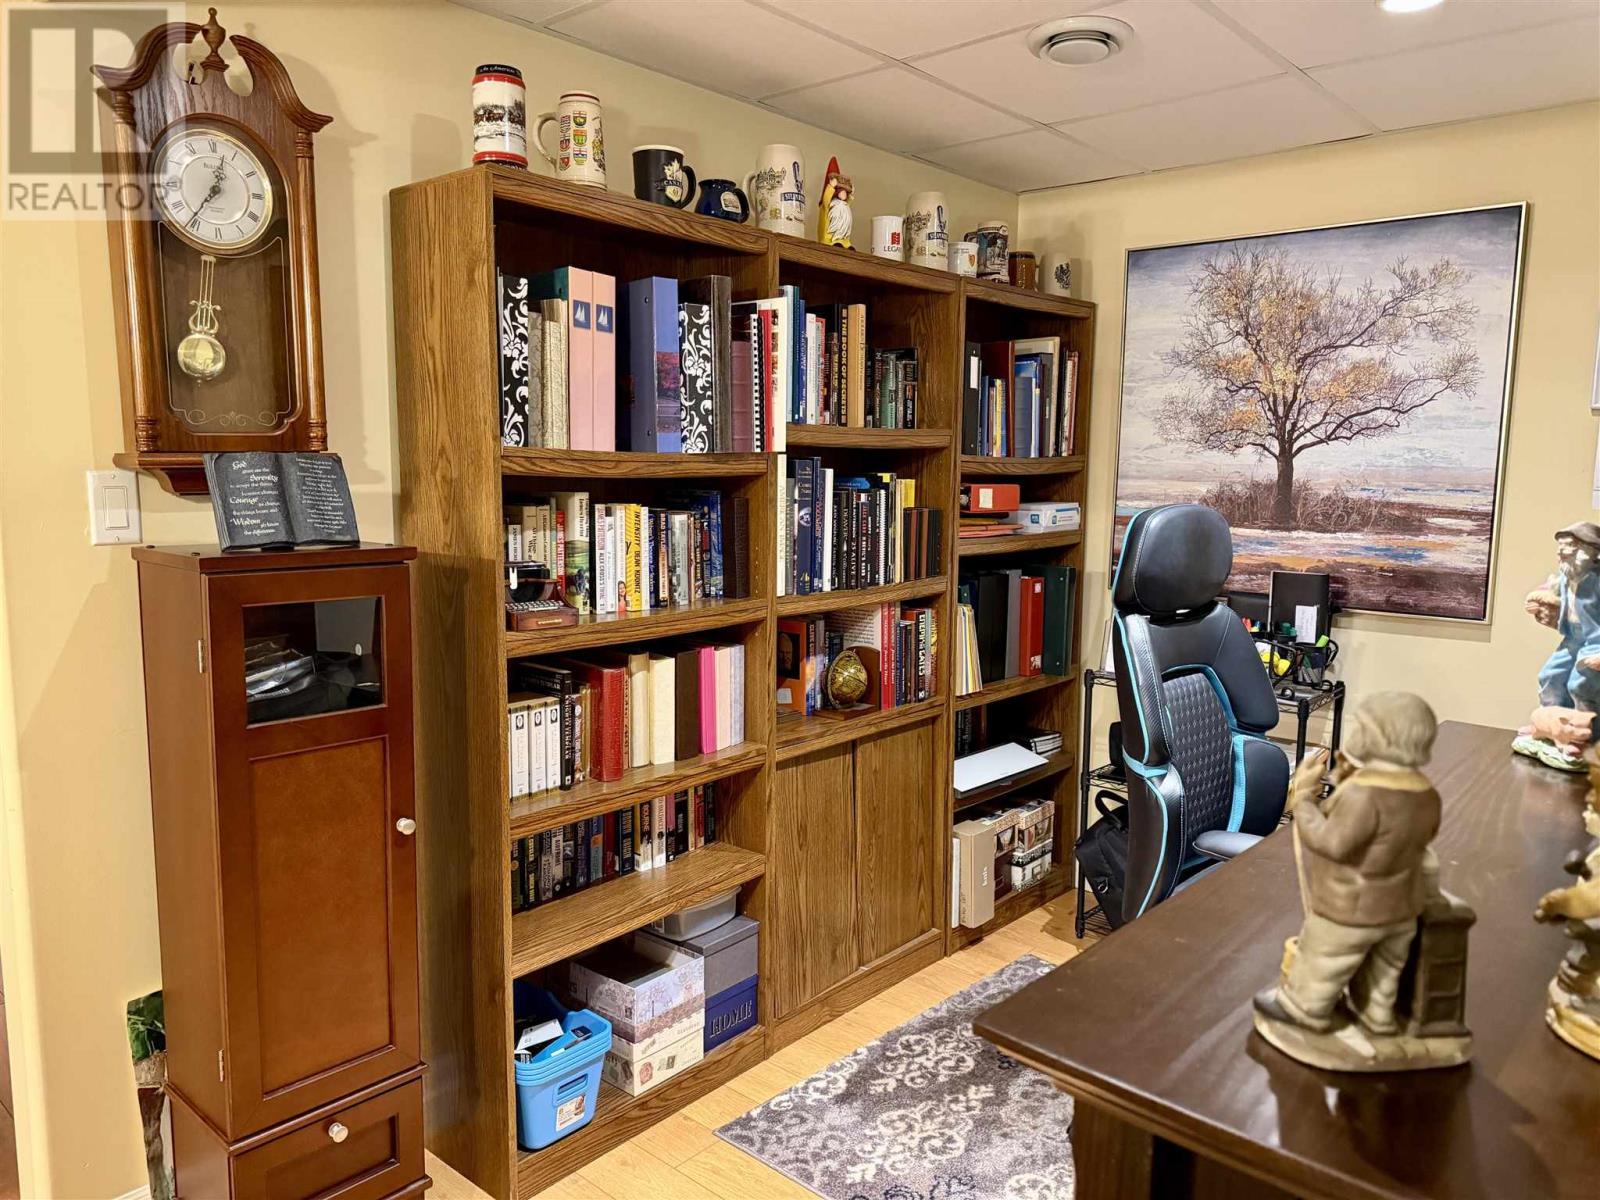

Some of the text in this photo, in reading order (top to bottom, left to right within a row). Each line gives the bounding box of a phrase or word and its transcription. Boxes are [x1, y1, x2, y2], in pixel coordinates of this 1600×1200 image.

[841, 365, 847, 379] OF
[250, 474, 278, 483] Serenity
[230, 497, 258, 505] Courage
[233, 518, 261, 526] Wisdom
[709, 1000, 753, 1039] HOME
